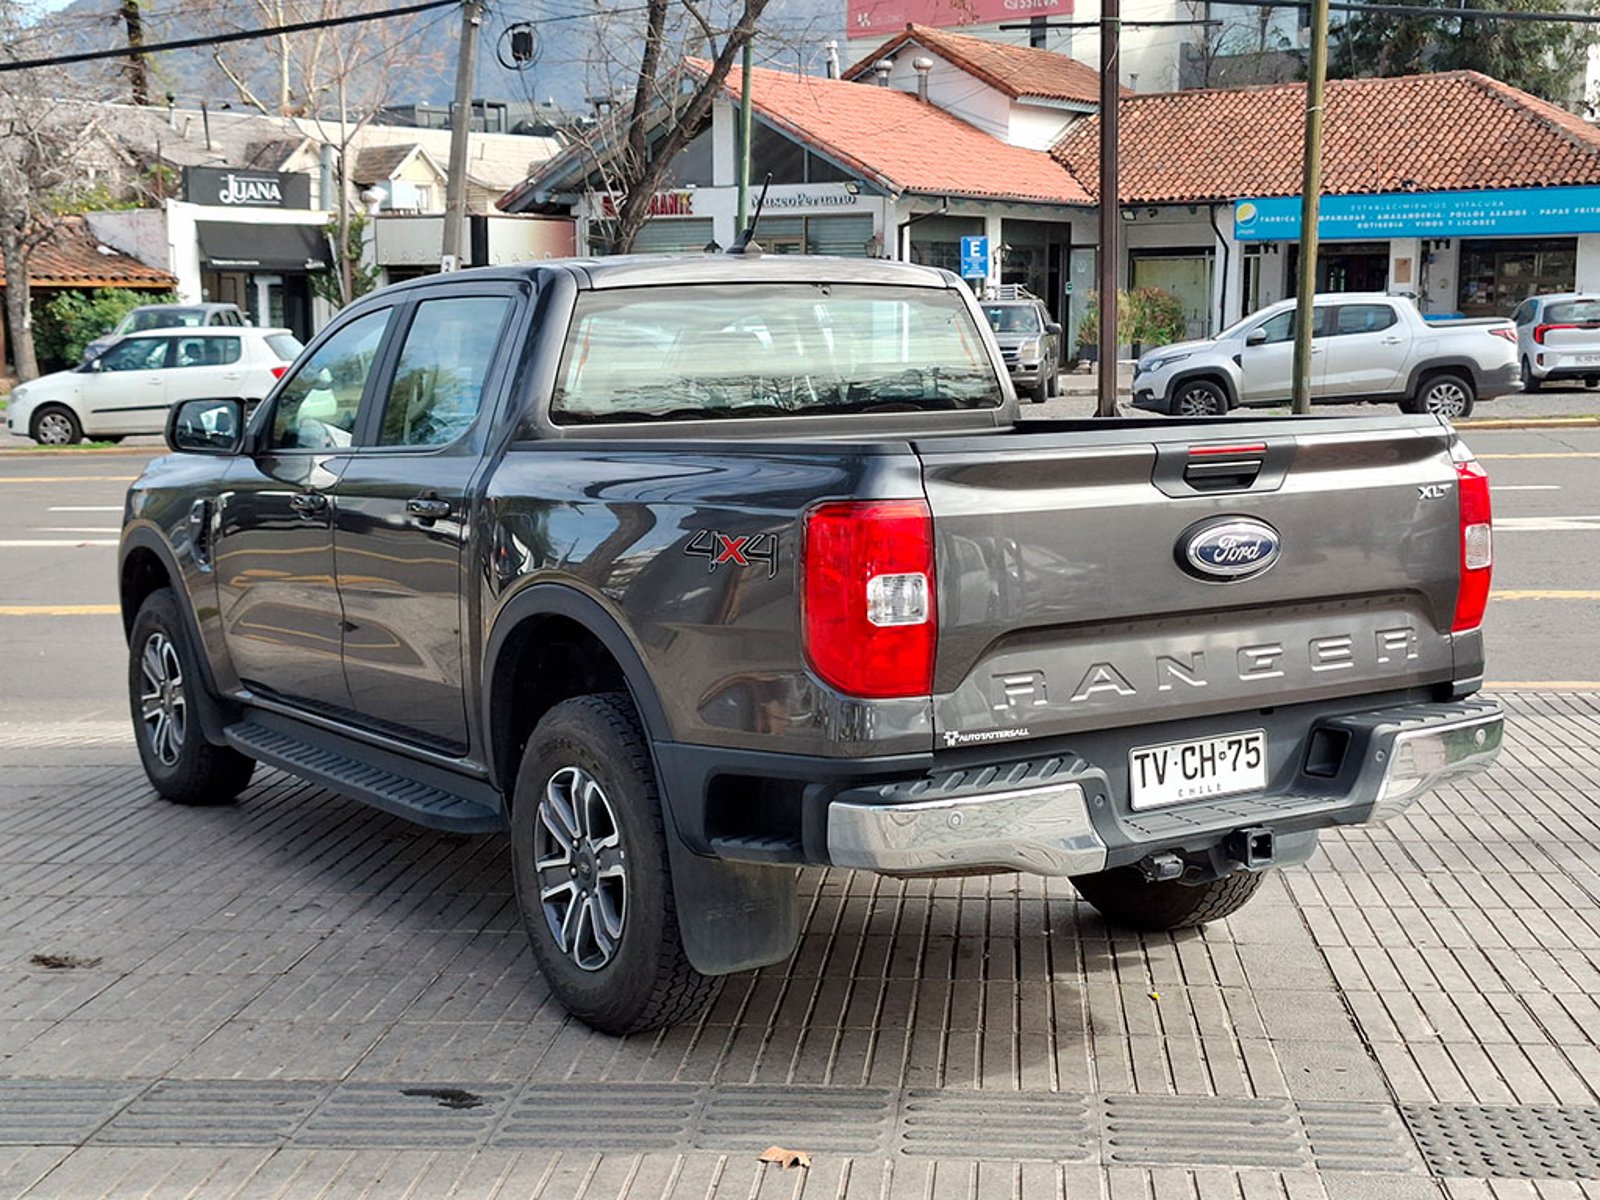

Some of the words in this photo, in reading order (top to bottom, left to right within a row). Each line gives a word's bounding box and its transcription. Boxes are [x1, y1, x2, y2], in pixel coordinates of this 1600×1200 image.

[219, 174, 281, 204] JUANA
[970, 241, 981, 257] E
[1213, 534, 1262, 563] Ford
[991, 626, 1419, 711] RANGER
[1177, 782, 1222, 798] CHILE
